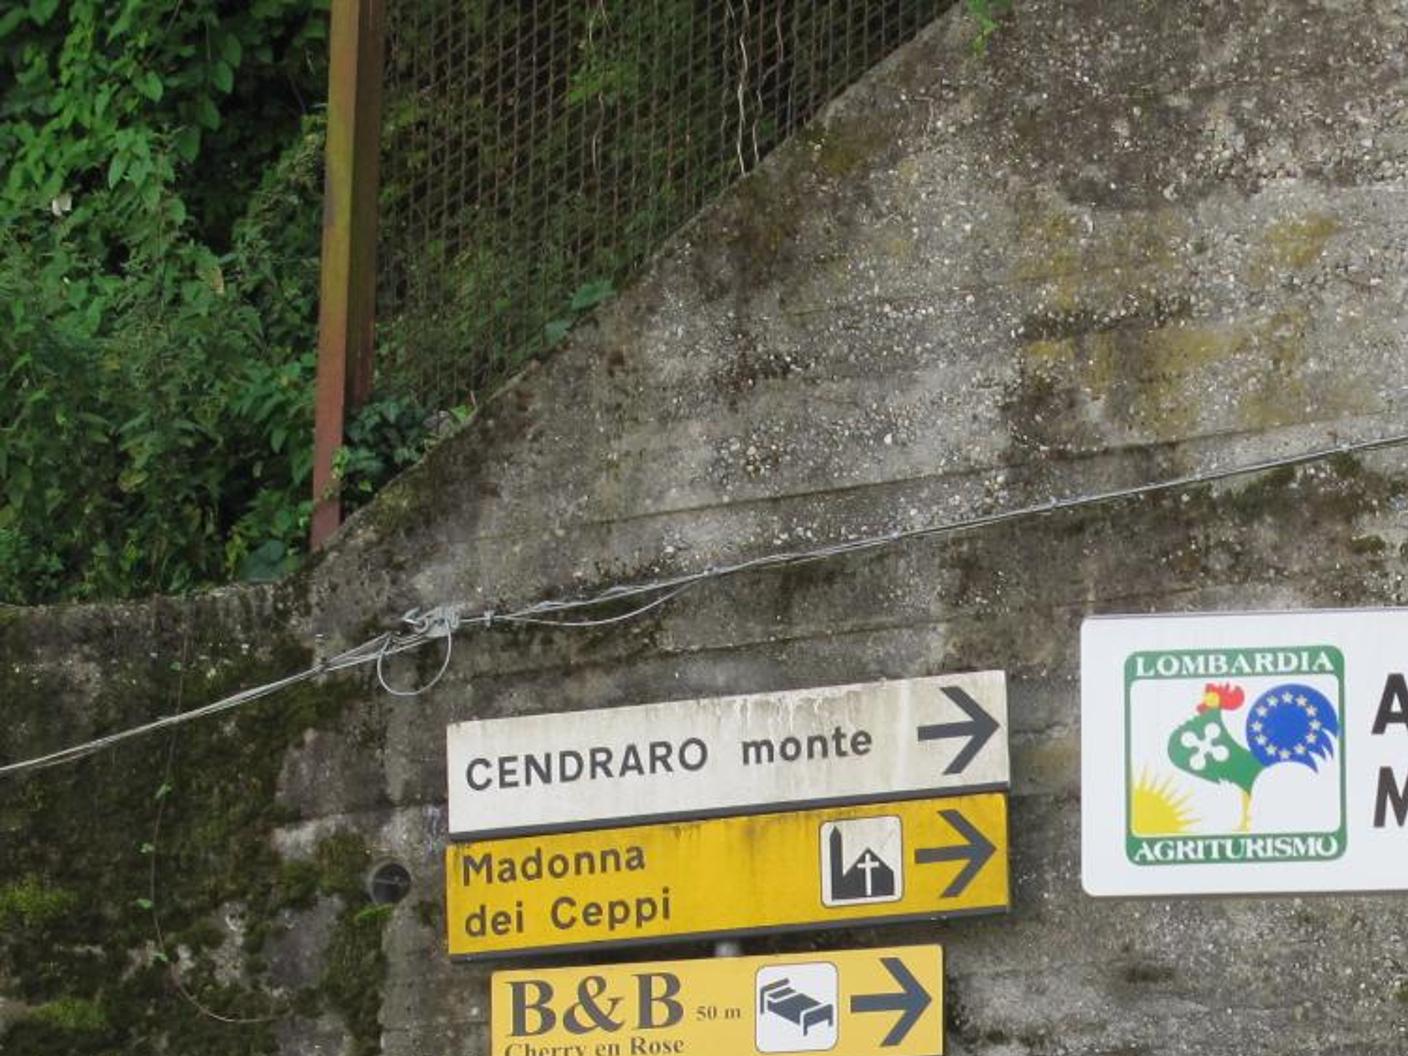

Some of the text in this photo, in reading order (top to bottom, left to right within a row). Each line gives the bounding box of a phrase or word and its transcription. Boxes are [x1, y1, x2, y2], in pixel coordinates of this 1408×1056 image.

[1135, 650, 1335, 678] LOMBARDIA
[465, 725, 873, 791] CENDRARO monte
[462, 843, 647, 887] Madonna
[1134, 836, 1339, 862] AGRITURISMO
[464, 887, 672, 938] dei Ceppi
[505, 972, 742, 1037] B&B 50 m
[594, 1041, 620, 1056] en
[629, 1037, 685, 1056] Rose
